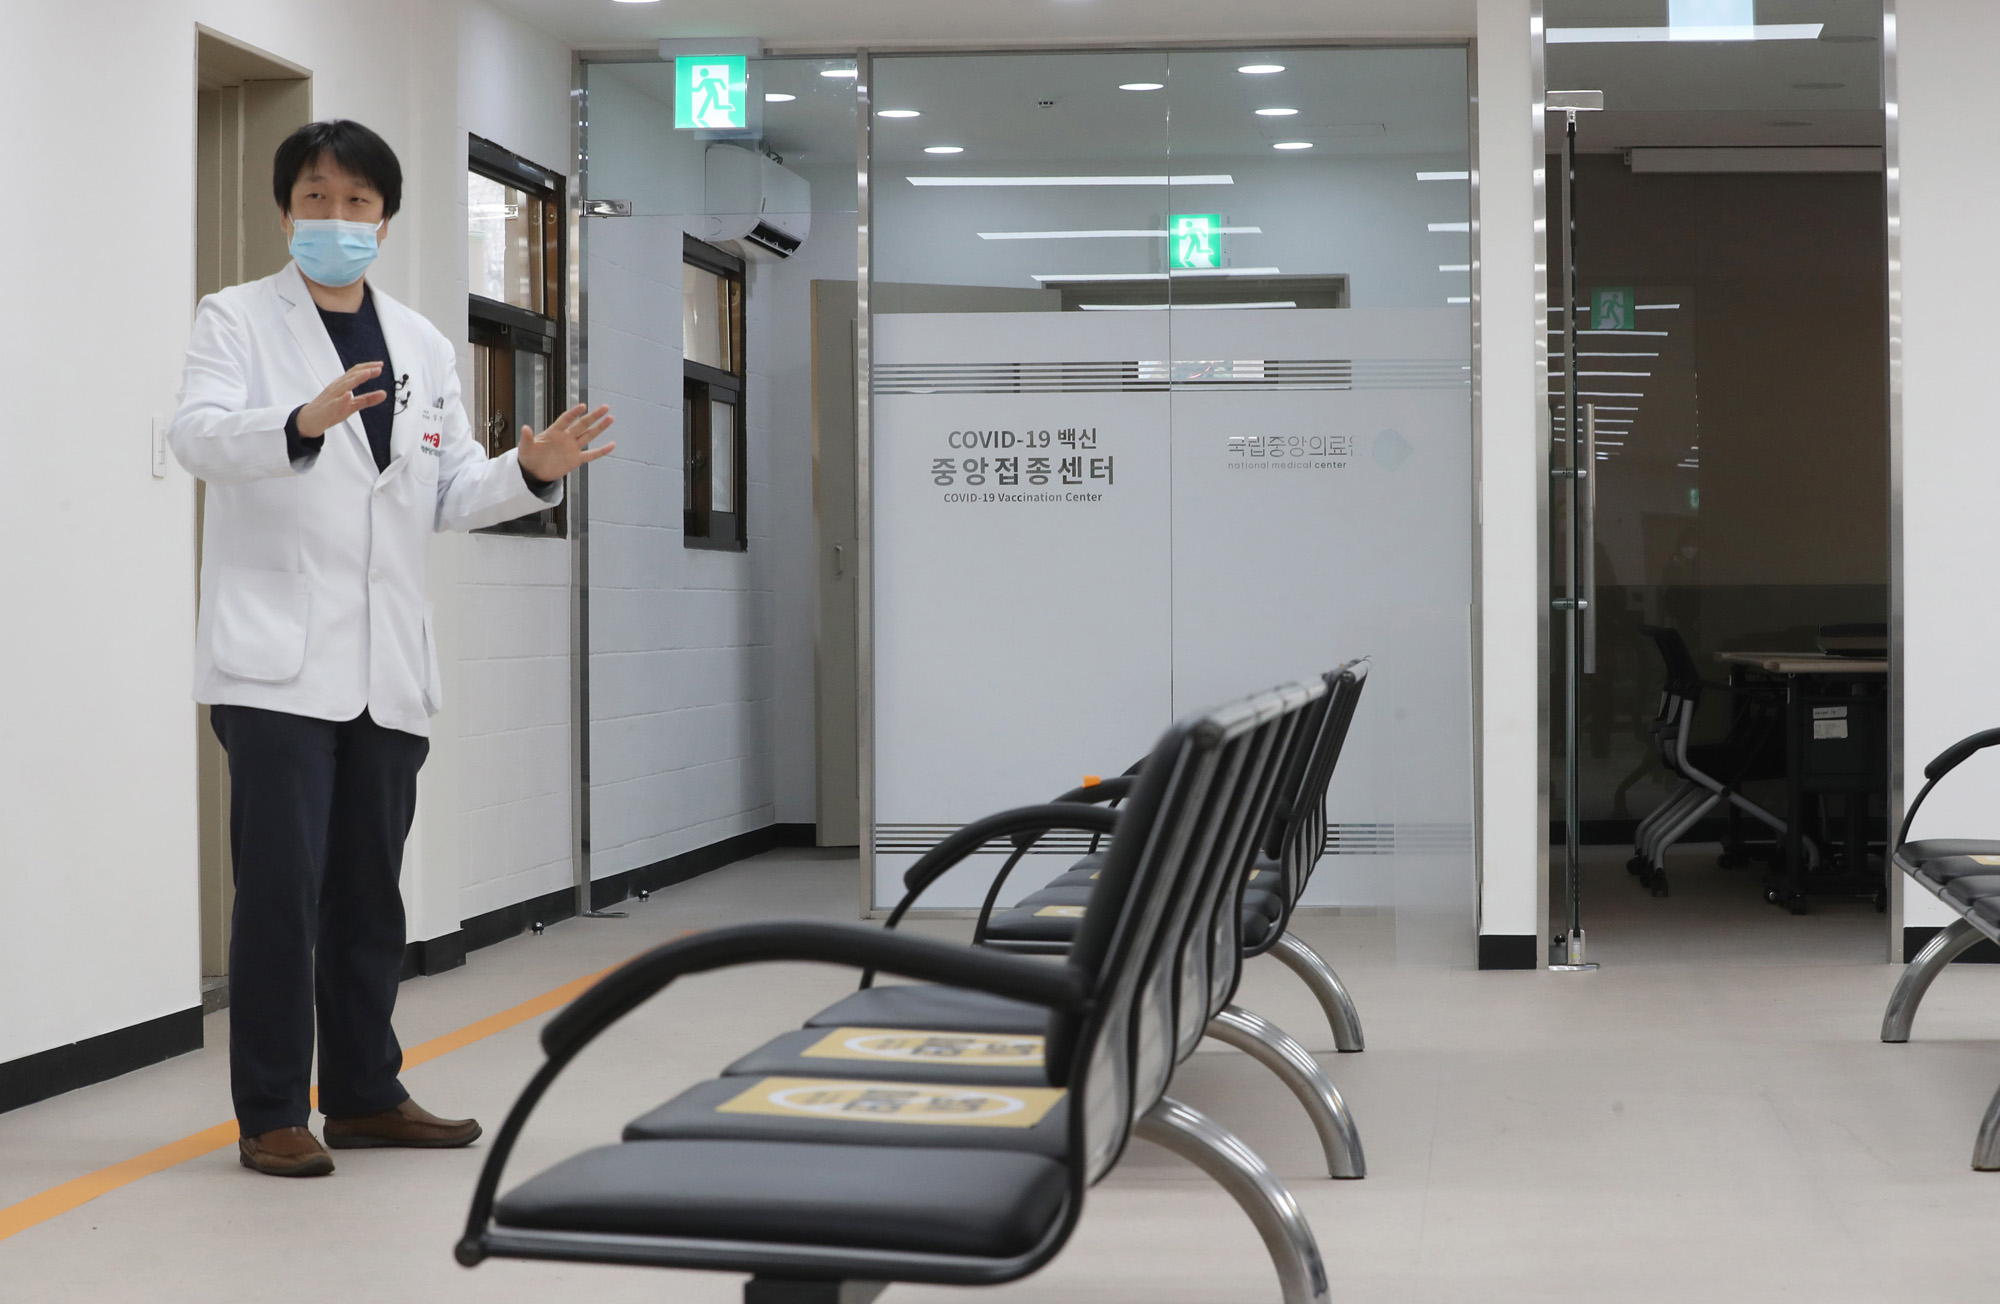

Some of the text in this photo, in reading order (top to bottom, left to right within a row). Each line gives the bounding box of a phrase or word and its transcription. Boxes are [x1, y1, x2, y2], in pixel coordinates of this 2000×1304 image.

[948, 428, 1097, 450] COVID-19 백신
[930, 455, 1114, 486] 중앙접종센터
[1228, 460, 1347, 470] national medical center
[943, 491, 1103, 503] COVID-19 Vaccination Center
